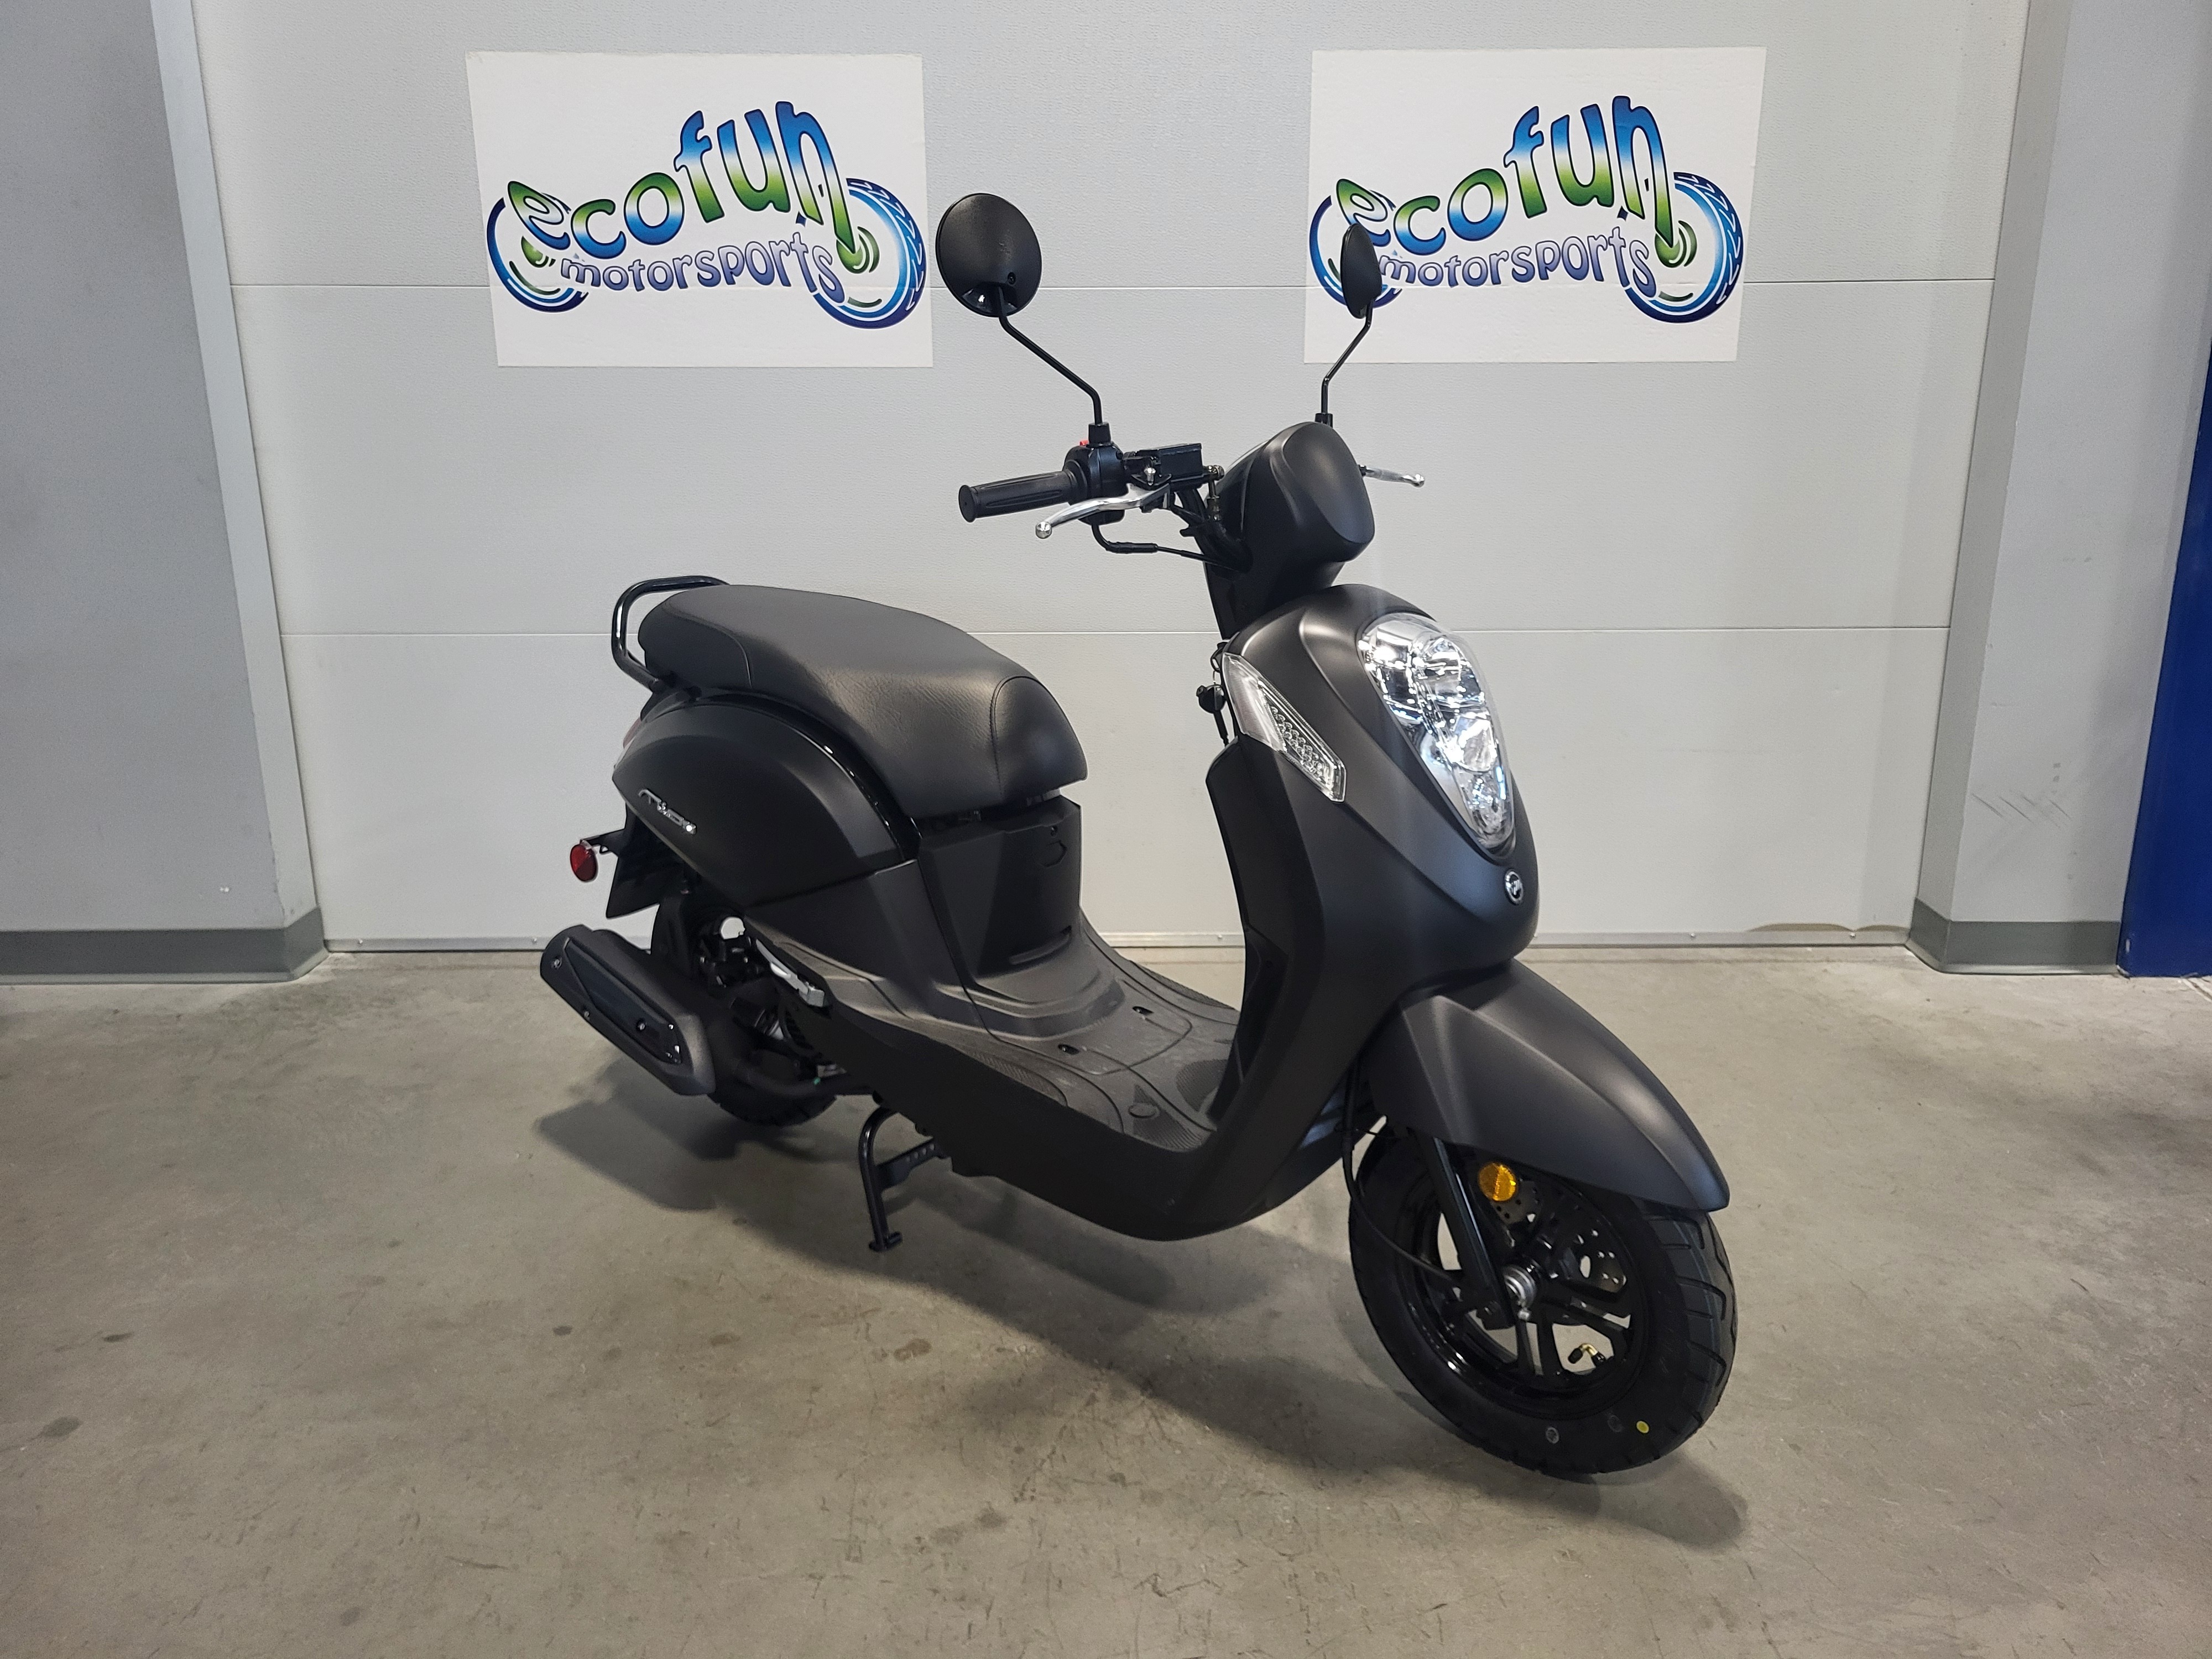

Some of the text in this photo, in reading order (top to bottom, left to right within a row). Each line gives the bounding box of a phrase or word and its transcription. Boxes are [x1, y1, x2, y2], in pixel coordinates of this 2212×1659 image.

[507, 101, 857, 260] ecofun
[1337, 96, 1674, 255] ecofun
[560, 233, 847, 304] motorsports
[1380, 227, 1657, 299] motorsports
